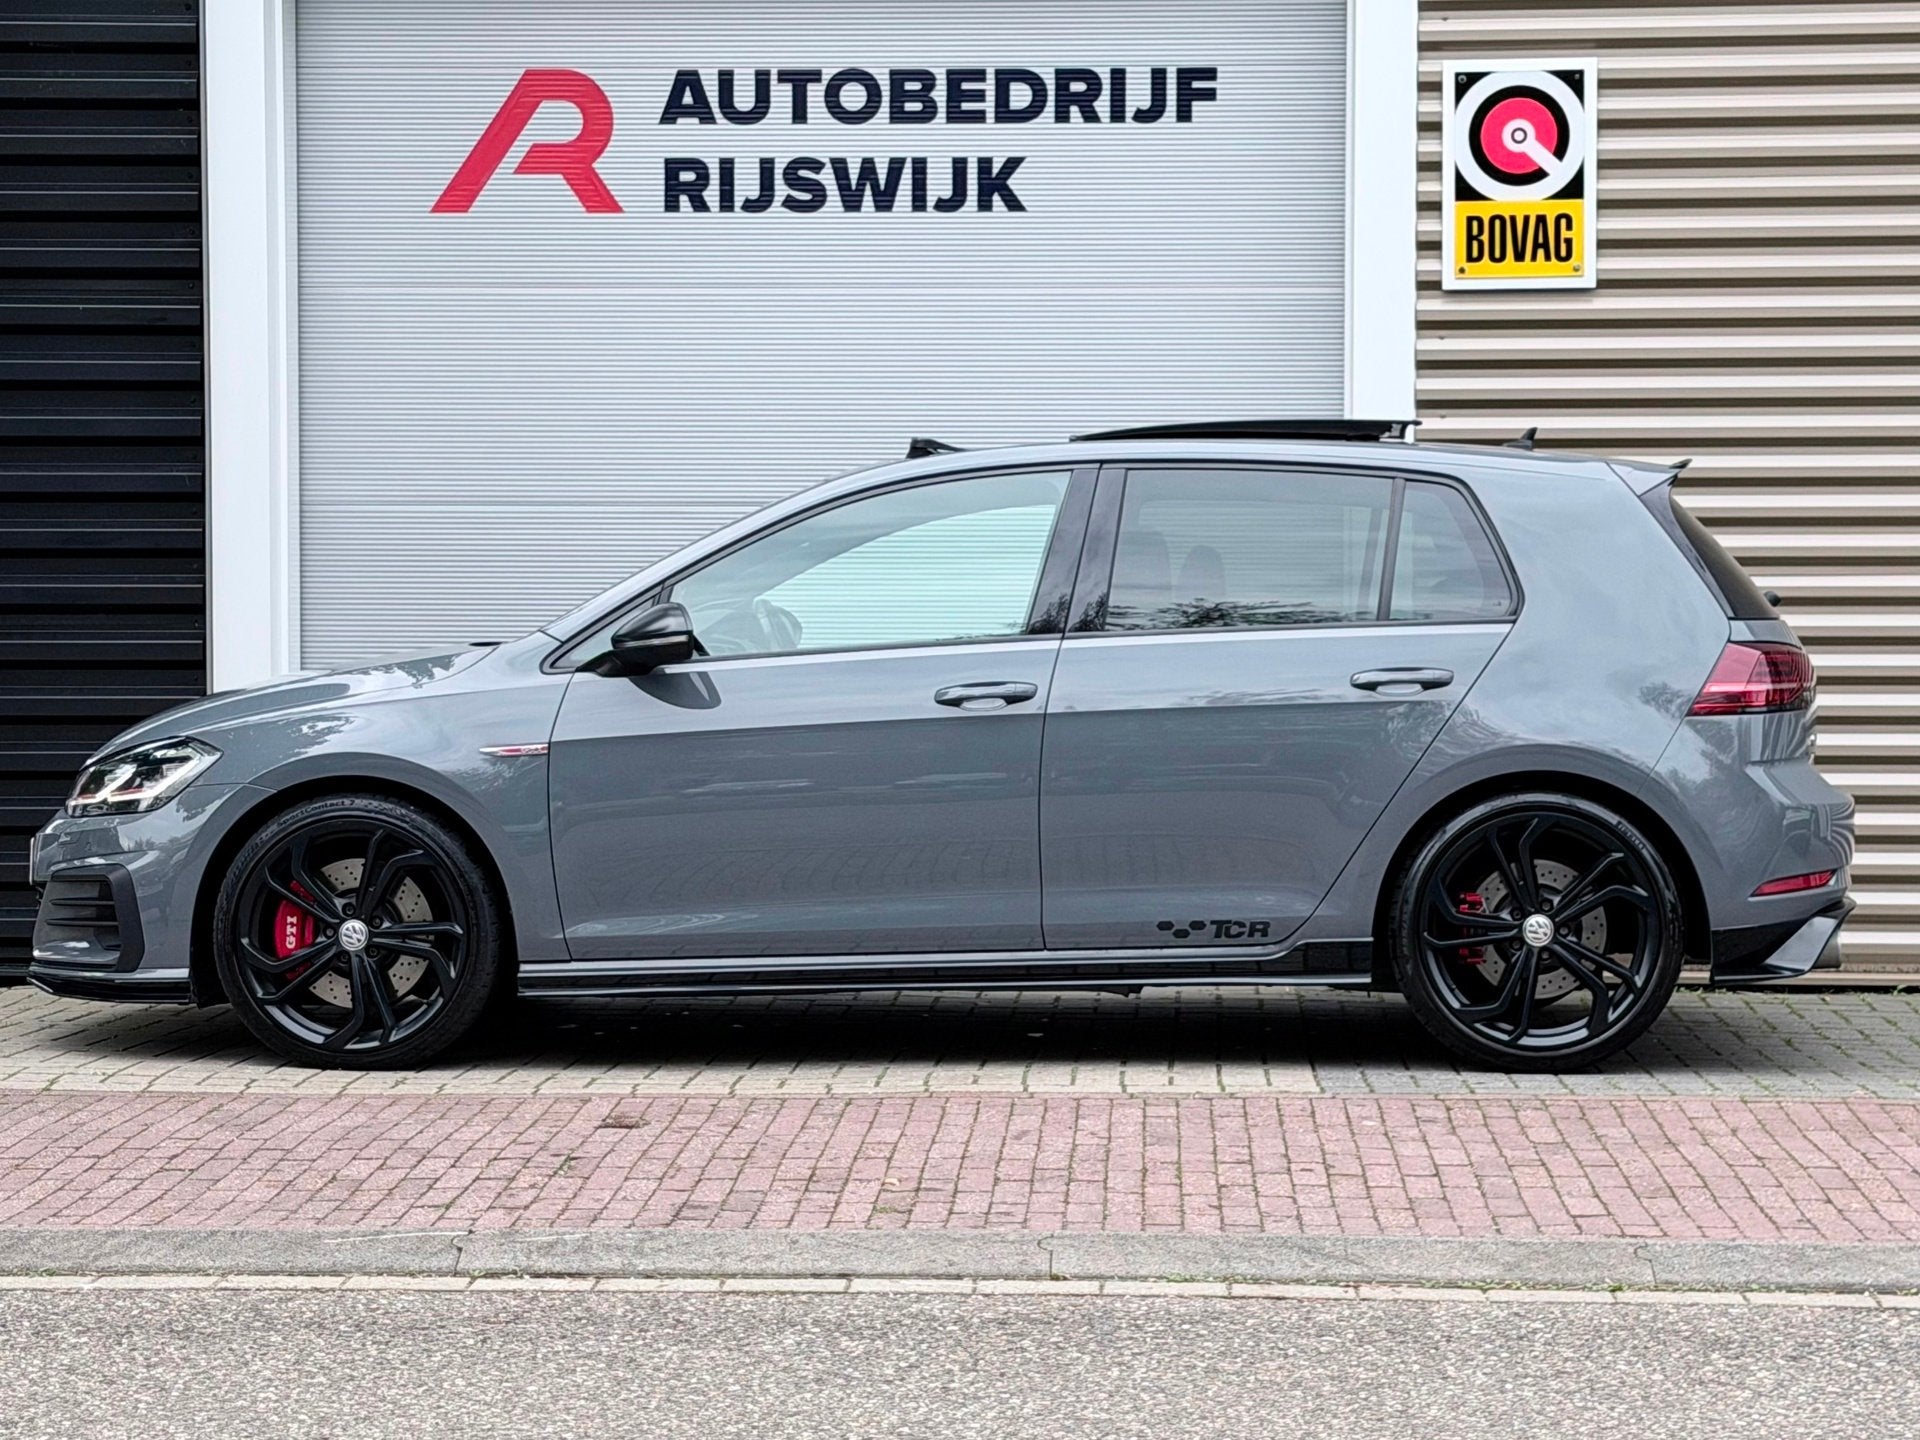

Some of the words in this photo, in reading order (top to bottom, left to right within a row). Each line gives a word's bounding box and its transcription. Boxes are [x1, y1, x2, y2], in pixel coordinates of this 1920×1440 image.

[658, 66, 1218, 126] AUTOBEDRIJF
[664, 157, 1027, 213] RIJSWIJK
[1465, 213, 1573, 263] BOVAG
[285, 916, 298, 949] GTI
[1209, 919, 1271, 939] TCR
